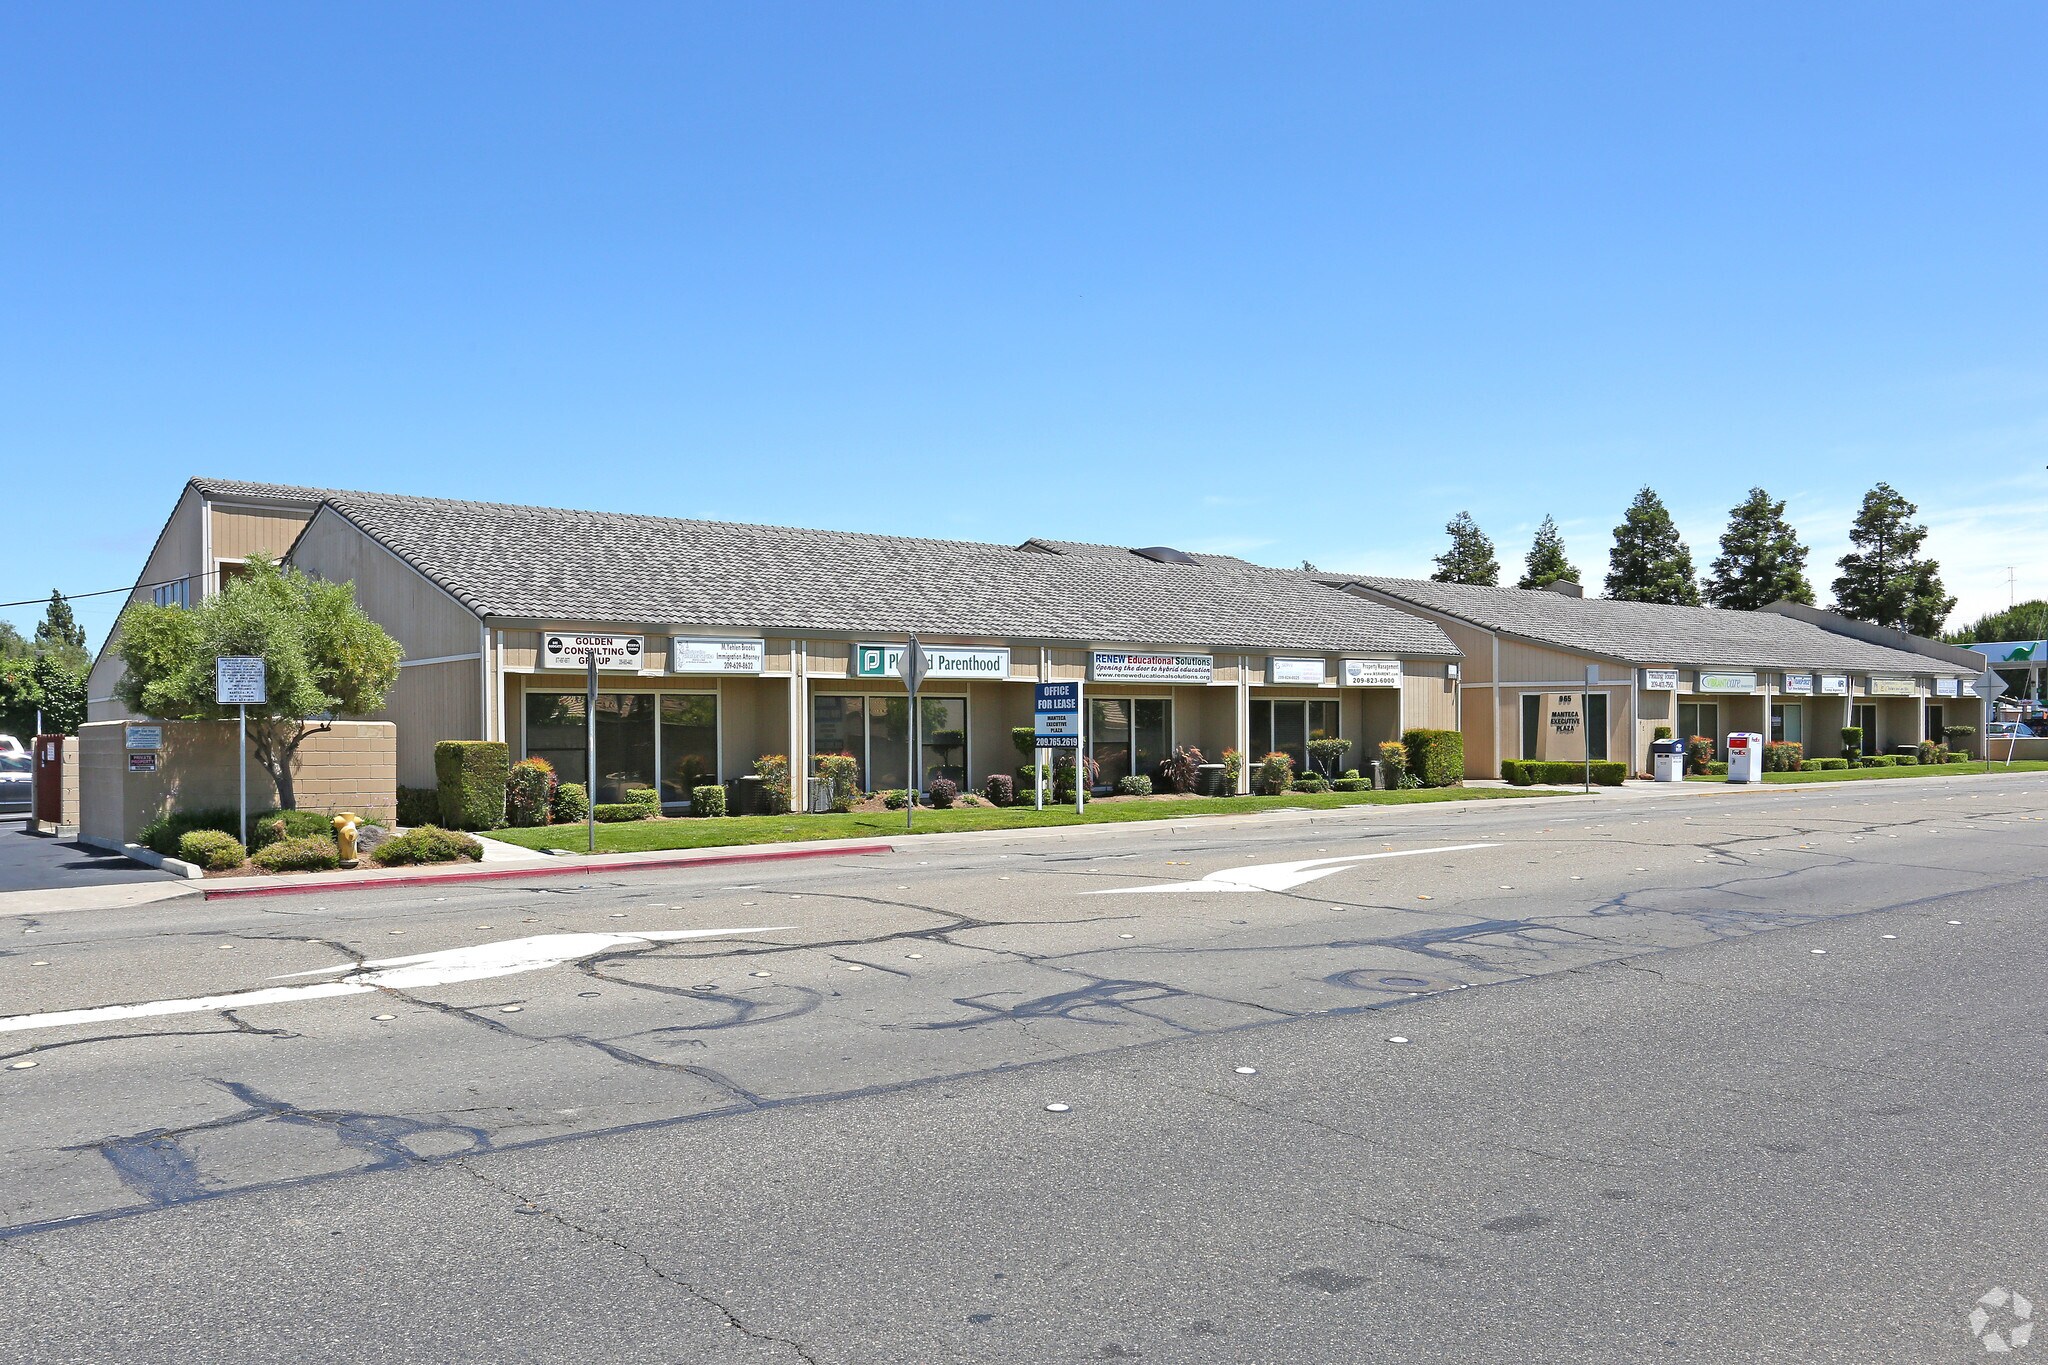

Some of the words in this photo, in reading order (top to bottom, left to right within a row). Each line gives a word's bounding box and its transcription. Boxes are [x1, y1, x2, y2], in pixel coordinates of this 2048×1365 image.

[575, 637, 613, 646] GOLDEN
[578, 656, 611, 665] GUP
[716, 652, 742, 661] Immigration
[742, 653, 760, 662] Attorney
[1095, 653, 1126, 664] RENEW
[1127, 655, 1174, 665] Educational
[1175, 656, 1211, 666] Solutions
[938, 655, 1000, 671] Parenthood
[1095, 664, 1122, 672] Opening
[1123, 663, 1134, 671] the
[1135, 664, 1150, 672] door
[1159, 665, 1179, 673] hybrid
[1362, 662, 1377, 670] Property
[1096, 672, 1210, 680] www.reneweducationalsolutions.org
[1044, 685, 1070, 696] OFFICE
[1037, 699, 1053, 710] FOR
[1053, 698, 1076, 709] LEASE
[1036, 737, 1078, 746] 209.765.2619
